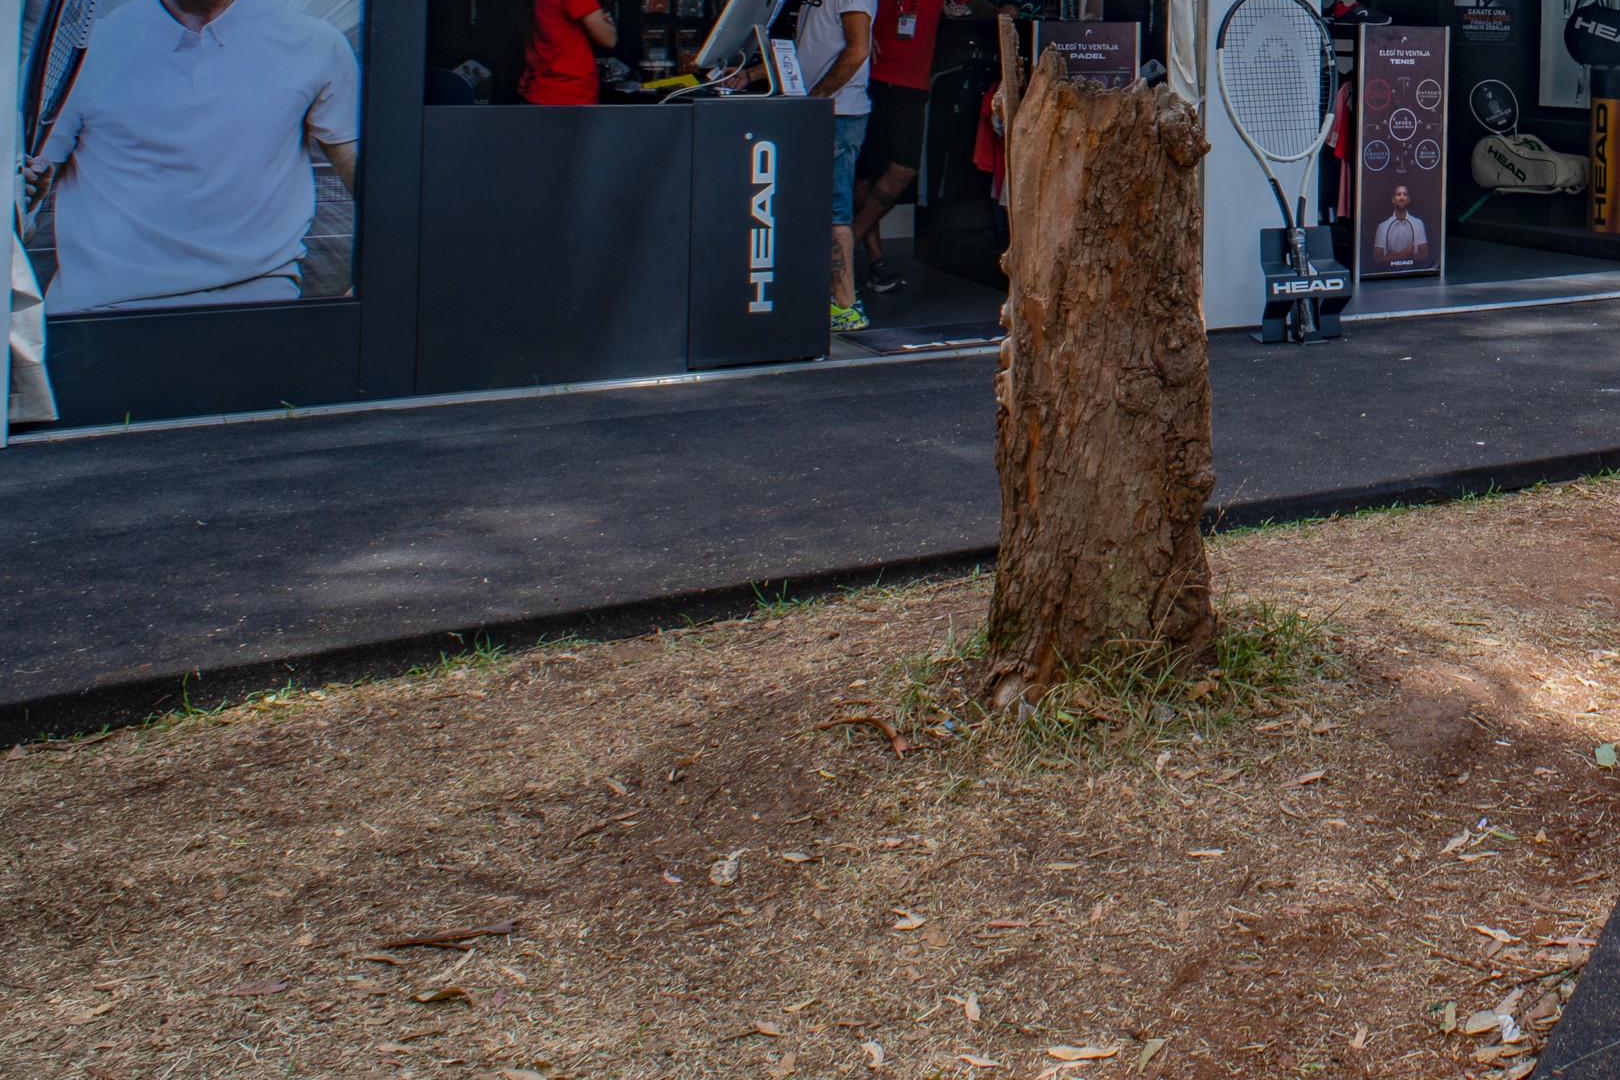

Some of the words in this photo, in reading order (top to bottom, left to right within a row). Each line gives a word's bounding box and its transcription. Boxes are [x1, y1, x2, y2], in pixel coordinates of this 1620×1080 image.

[1078, 43, 1087, 51] TU
[1089, 43, 1119, 51] VENTAJA
[1379, 49, 1395, 57] ELEGÍ
[1487, 145, 1526, 182] HEAD
[1594, 103, 1608, 226] HEAD
[749, 139, 777, 313] HEAD
[1273, 277, 1344, 295] HEAD
